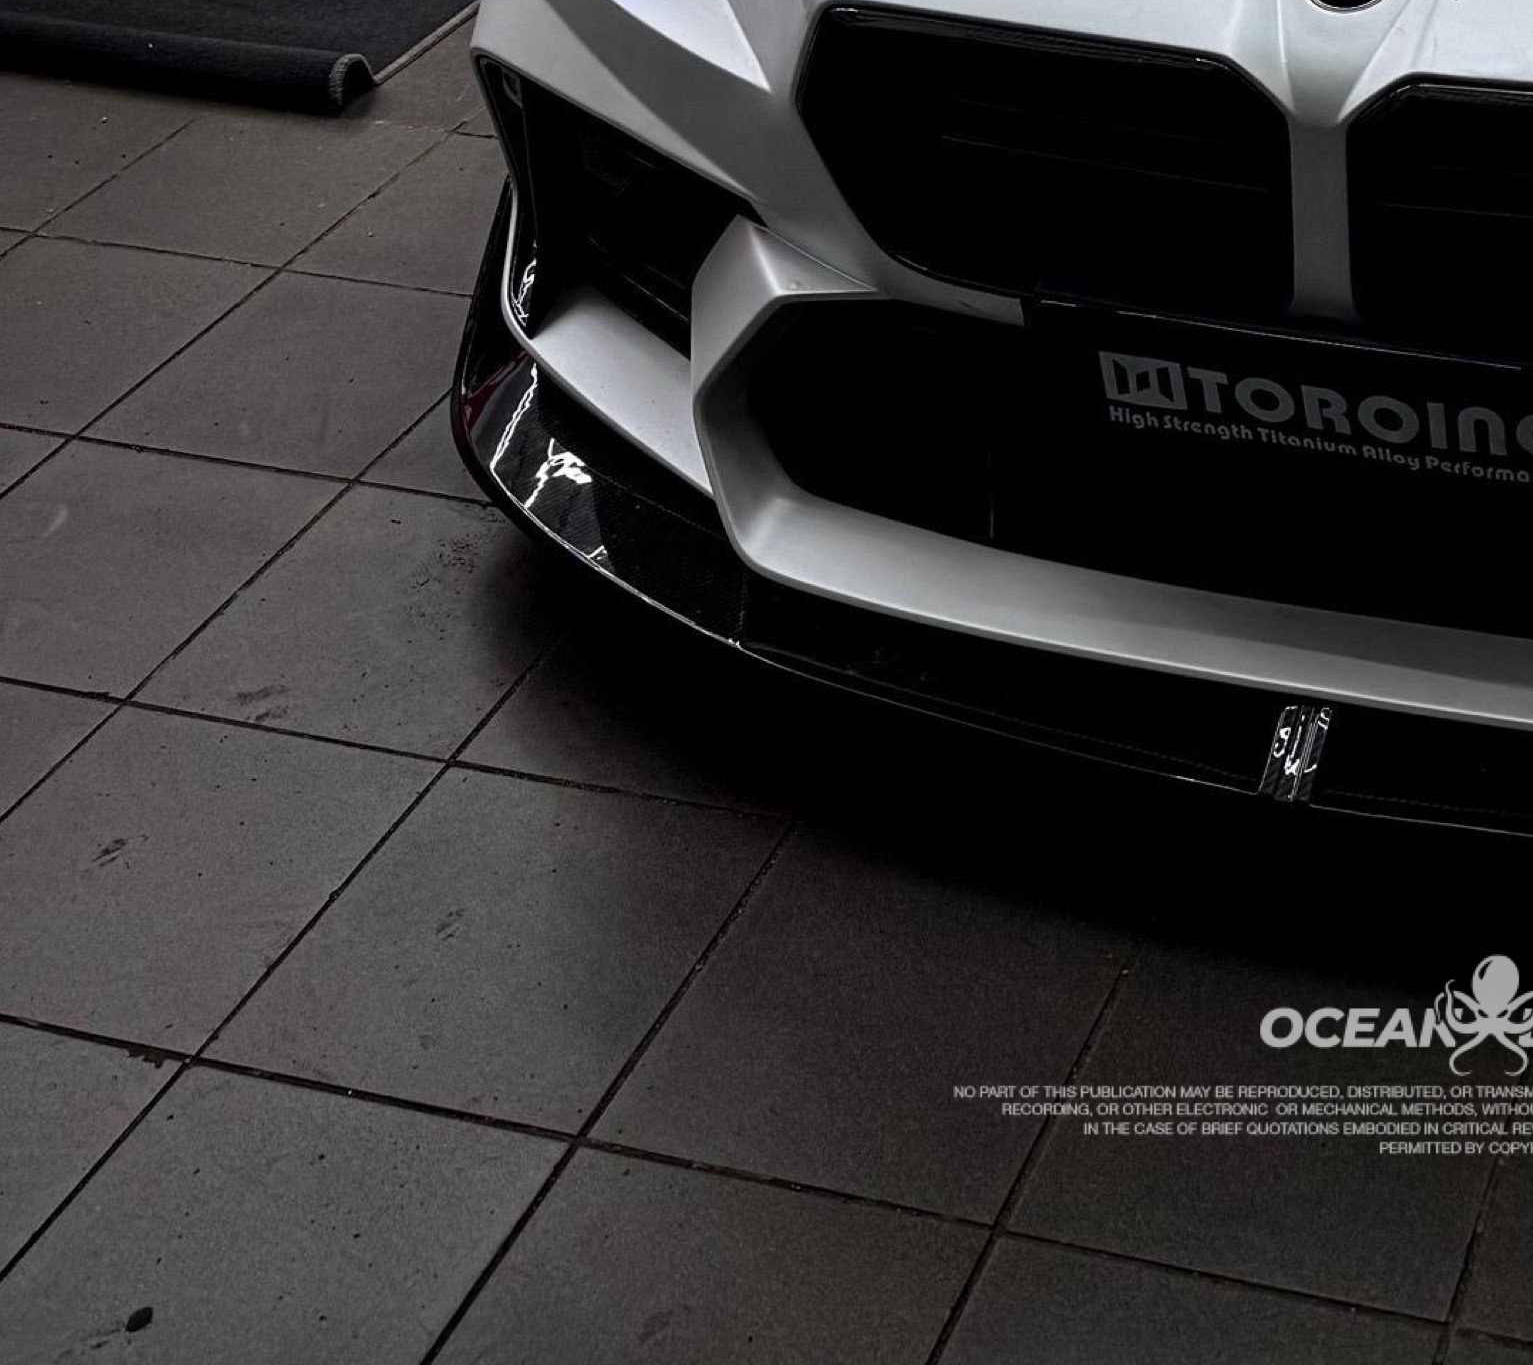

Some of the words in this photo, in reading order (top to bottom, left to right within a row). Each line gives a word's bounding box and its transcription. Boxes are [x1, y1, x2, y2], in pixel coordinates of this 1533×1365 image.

[1109, 405, 1161, 430] High
[1162, 413, 1254, 441] Strength
[1256, 425, 1359, 457] Titanium
[1362, 444, 1421, 472] Alloy
